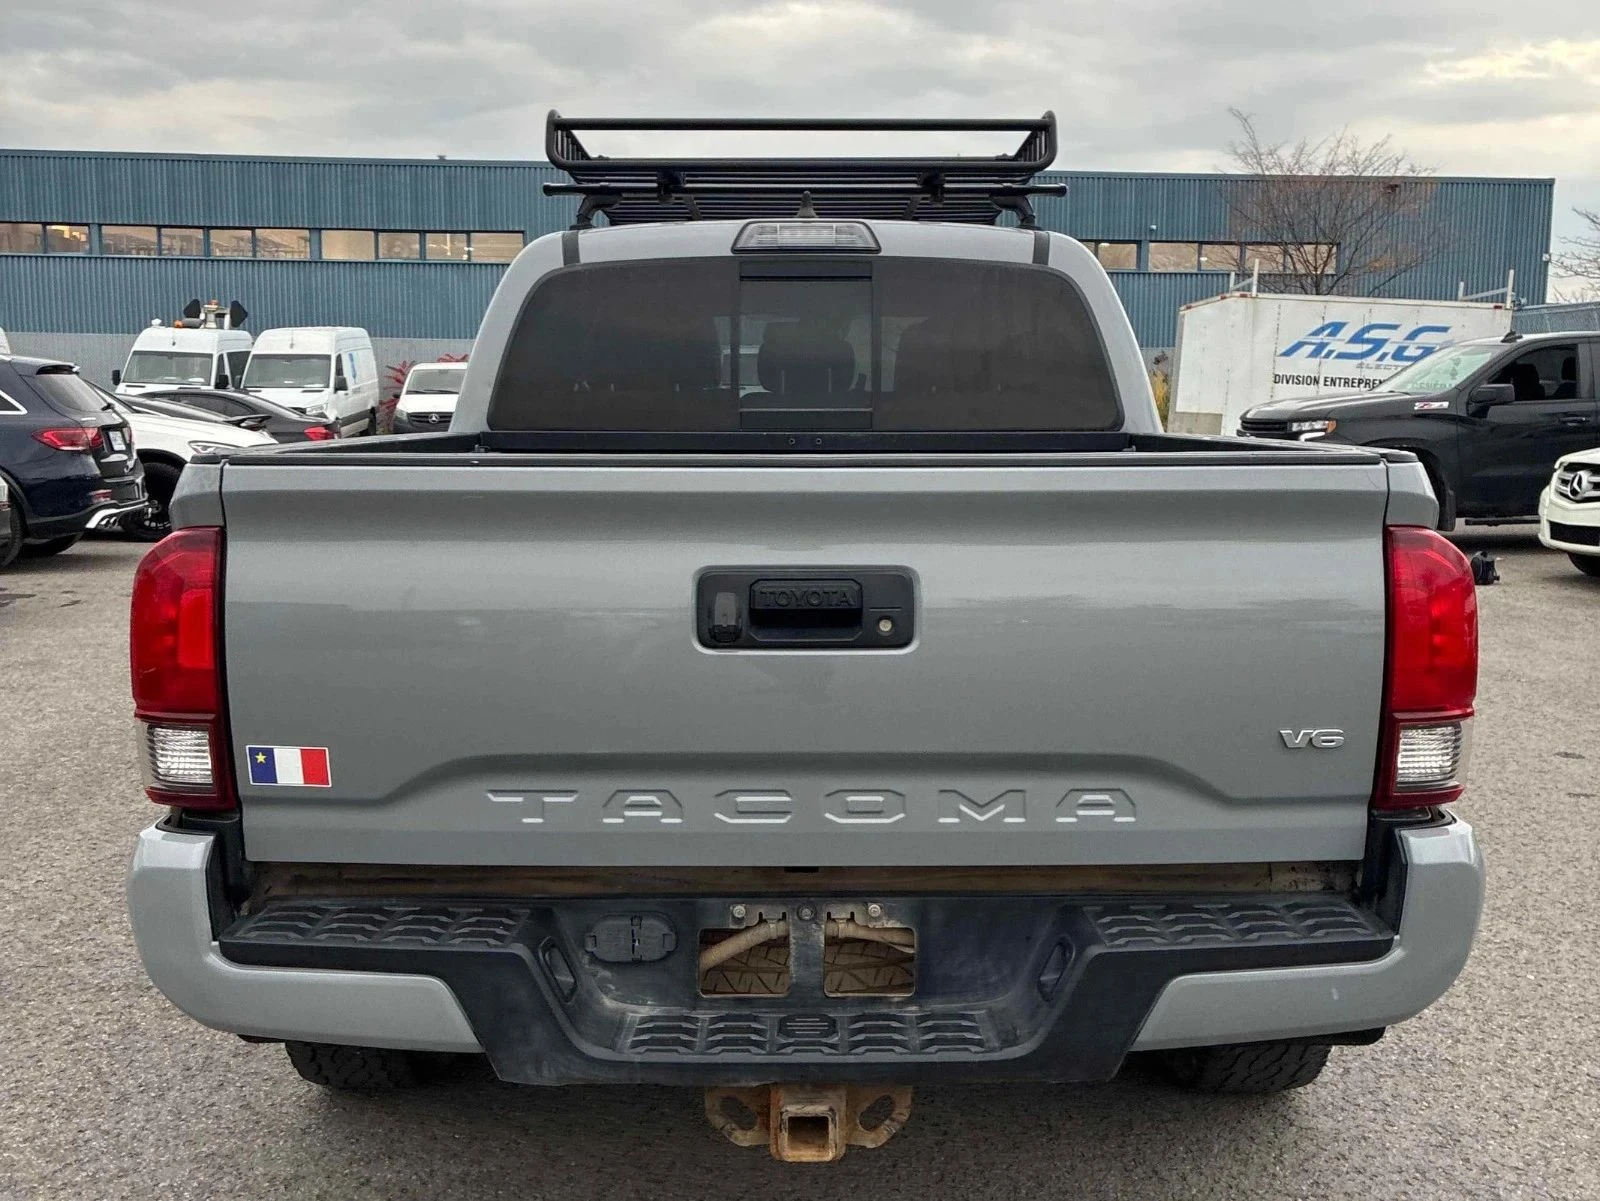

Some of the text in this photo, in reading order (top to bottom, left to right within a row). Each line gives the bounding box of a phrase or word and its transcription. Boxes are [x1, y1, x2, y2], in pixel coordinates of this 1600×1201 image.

[1274, 373, 1319, 386] DIVISION
[758, 590, 857, 608] TOYOTA
[1280, 729, 1344, 748] V6
[487, 789, 1137, 823] TACOMA
